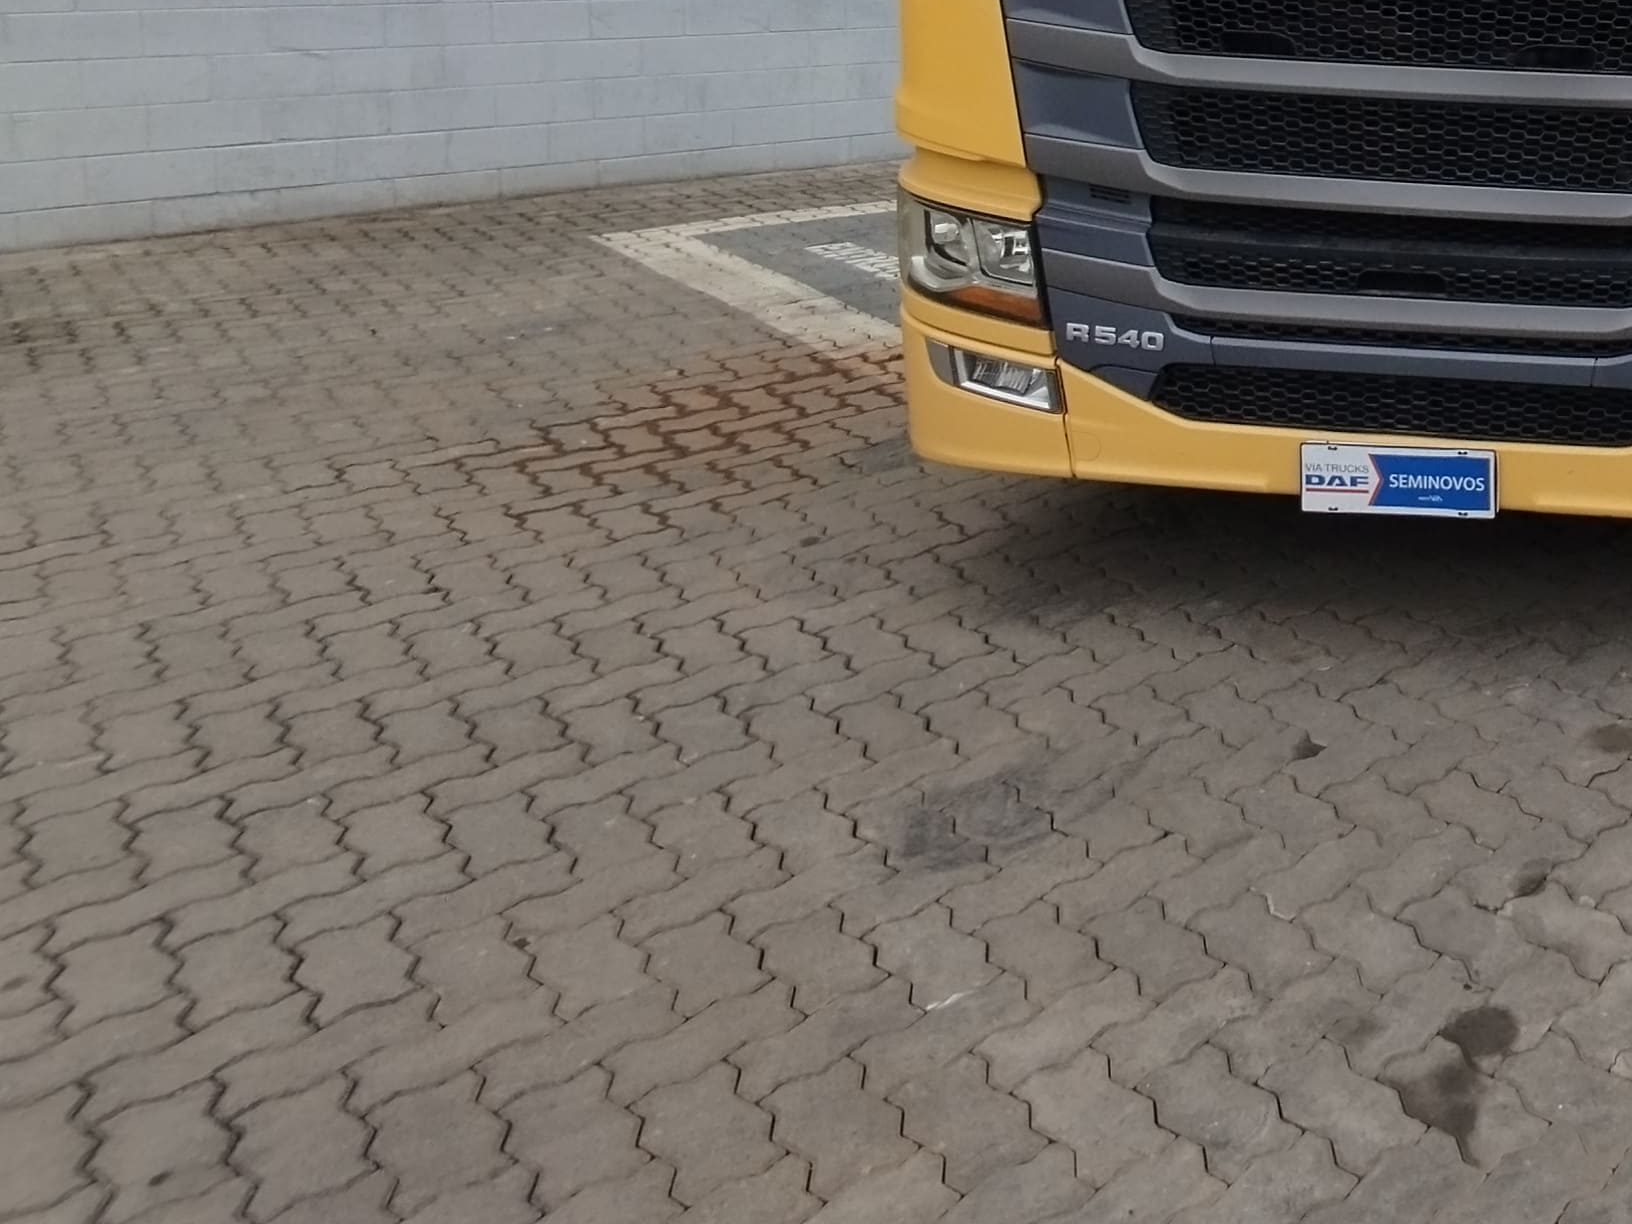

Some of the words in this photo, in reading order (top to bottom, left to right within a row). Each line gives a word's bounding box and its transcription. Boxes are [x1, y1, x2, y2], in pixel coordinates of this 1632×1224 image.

[1305, 463, 1324, 473] VIA
[1326, 463, 1369, 474] TRUCKS
[1305, 474, 1369, 487] DAF
[1389, 473, 1485, 492] SEMINOVOS
